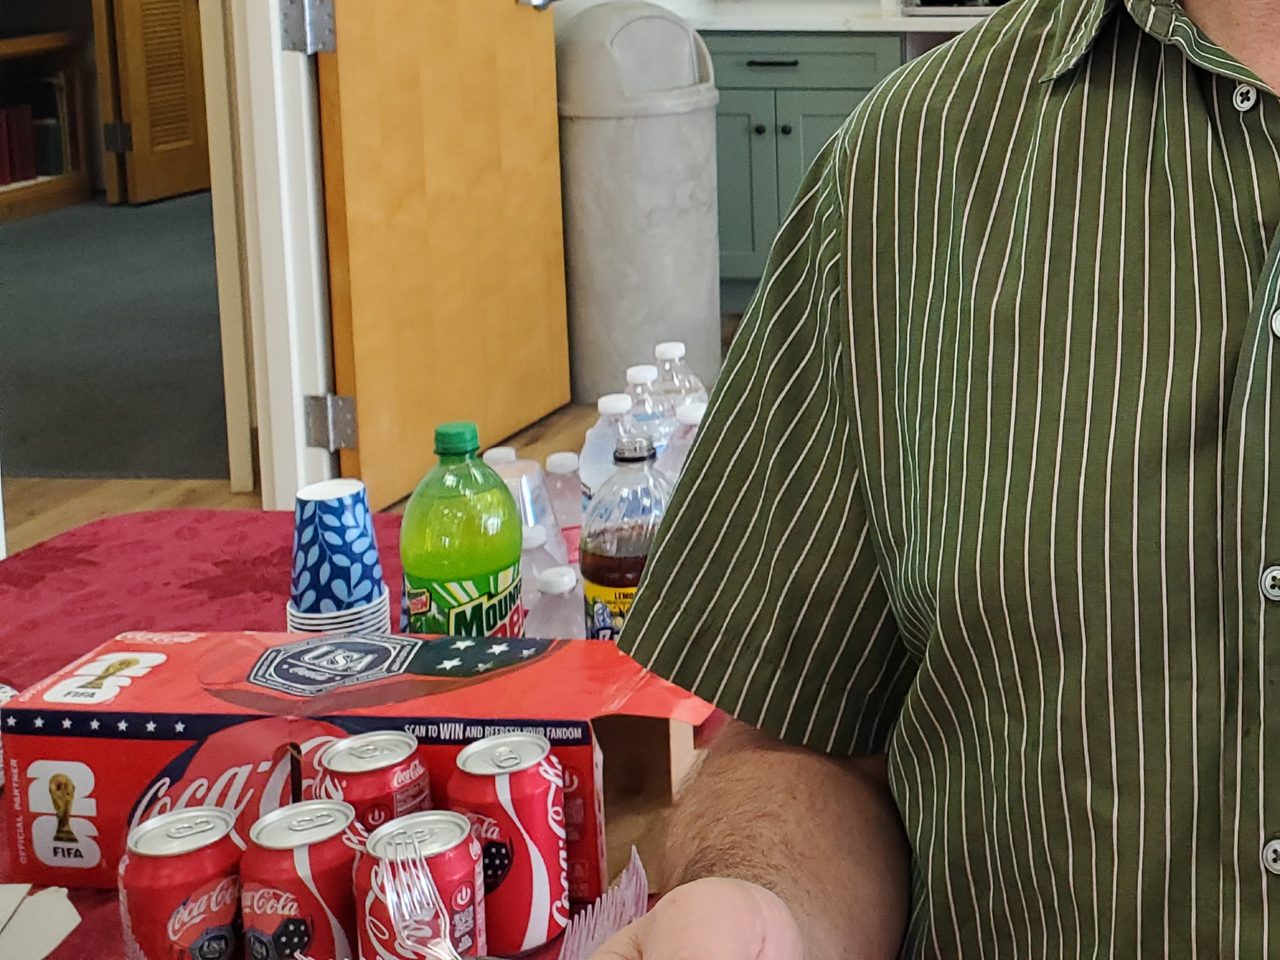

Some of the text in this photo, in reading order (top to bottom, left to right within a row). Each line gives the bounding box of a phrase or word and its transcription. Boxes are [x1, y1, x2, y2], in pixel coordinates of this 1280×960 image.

[614, 592, 634, 600] LEMO
[454, 580, 522, 638] MOUN
[63, 691, 96, 699] FIFA
[404, 724, 426, 738] SCAN
[427, 725, 438, 738] TO
[440, 723, 464, 740] WIN
[465, 726, 483, 738] AND
[546, 727, 582, 739] FANDOM
[10, 759, 27, 864] OFFICIAL PARTNER
[52, 846, 84, 859] FIFA
